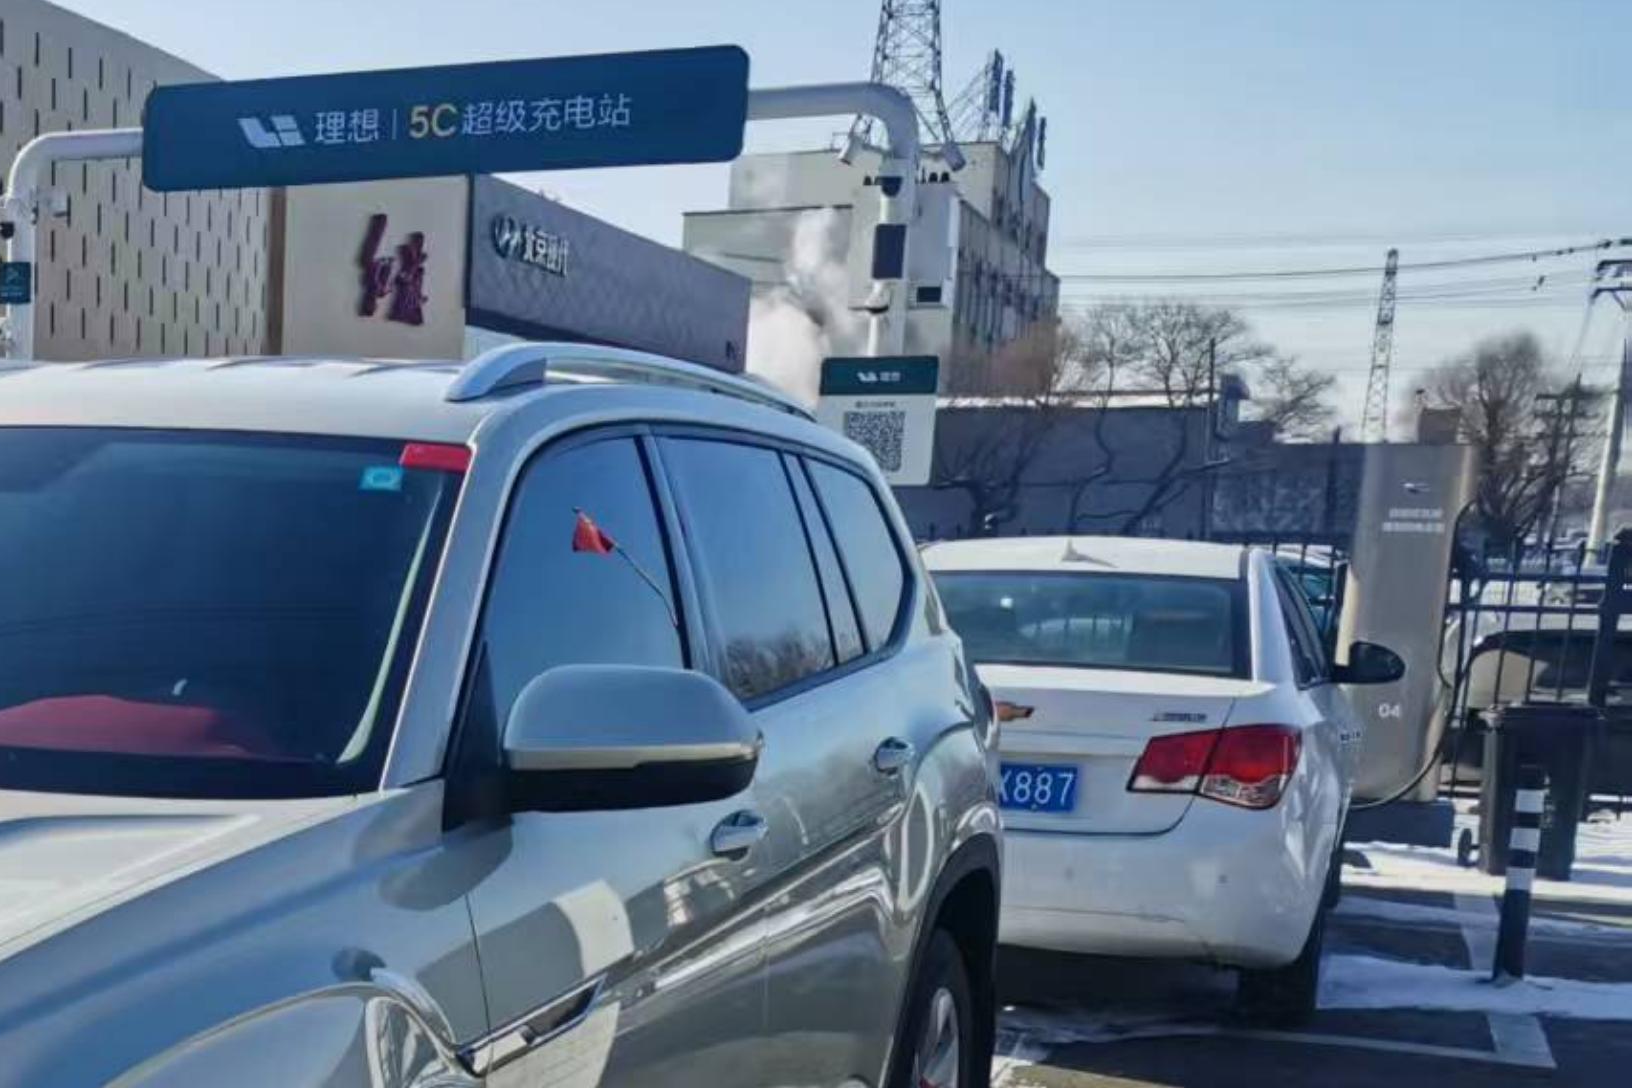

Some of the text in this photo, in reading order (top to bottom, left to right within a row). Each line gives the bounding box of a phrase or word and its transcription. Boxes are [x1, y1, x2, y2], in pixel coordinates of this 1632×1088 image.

[314, 93, 632, 146] 理想 5C超级充电站
[1378, 703, 1401, 718] 04
